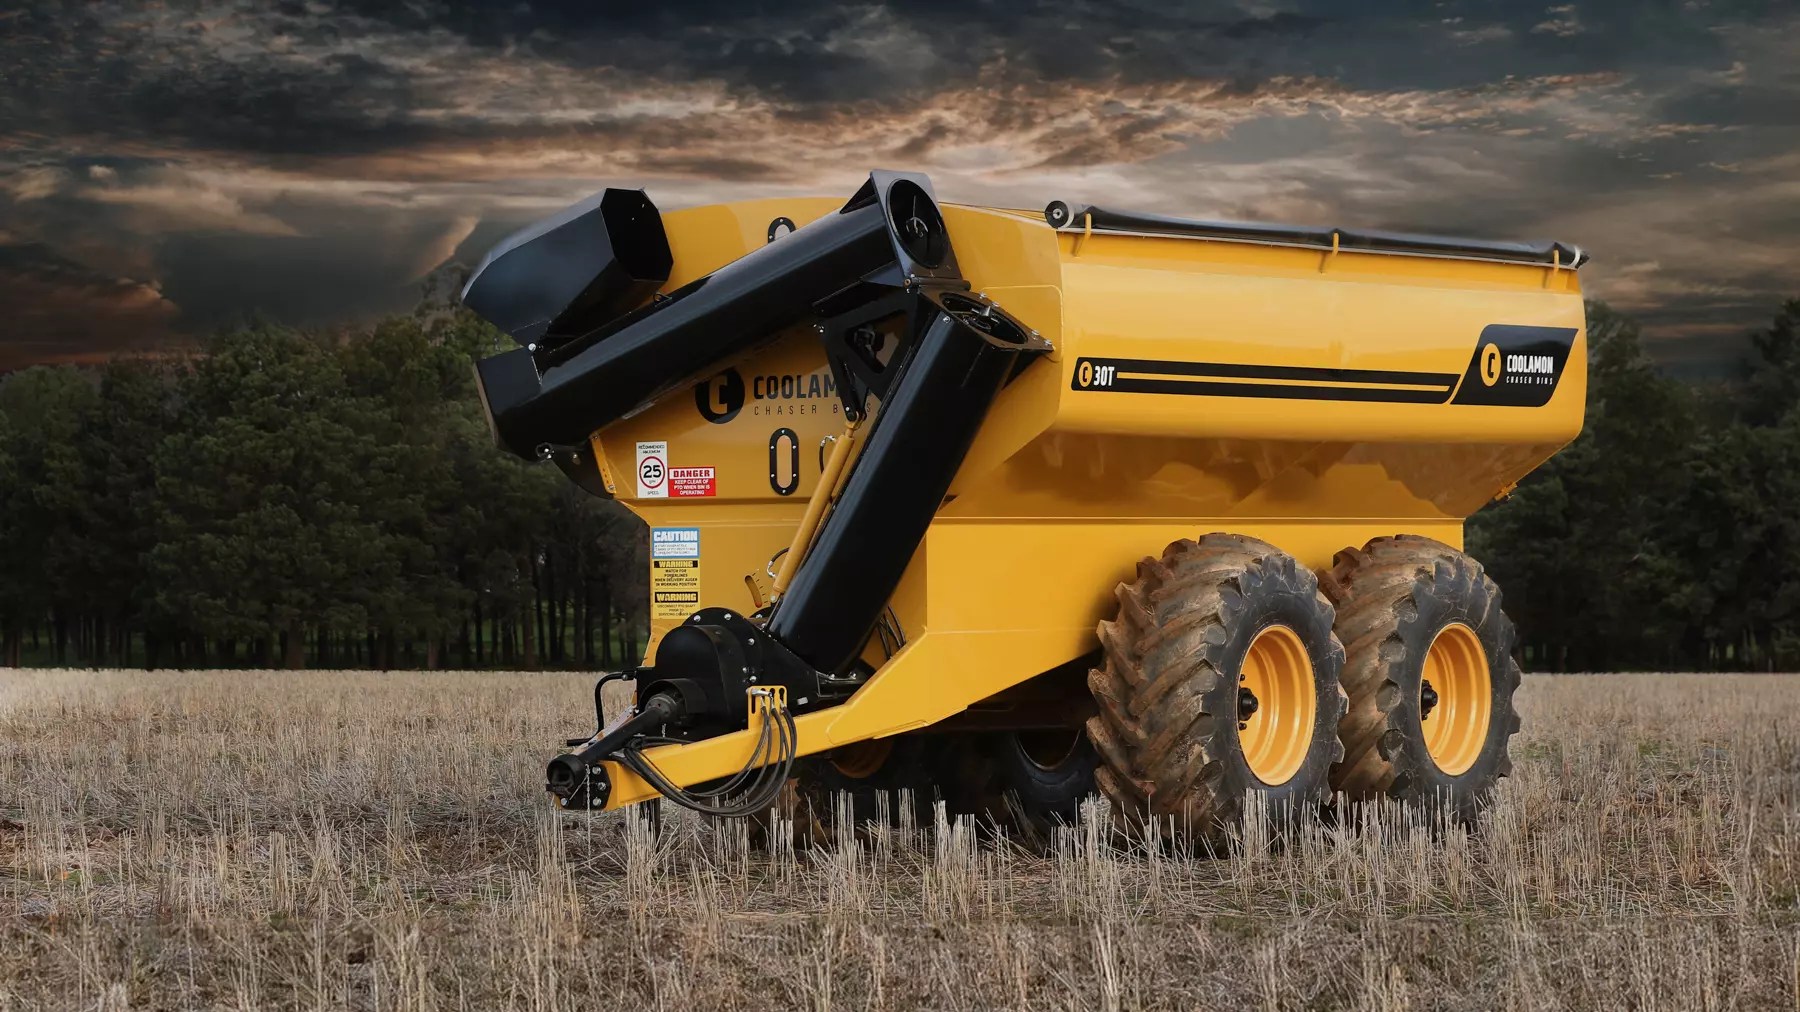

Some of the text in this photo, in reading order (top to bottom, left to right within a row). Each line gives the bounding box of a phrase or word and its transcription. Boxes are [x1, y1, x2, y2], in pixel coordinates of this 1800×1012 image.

[1506, 354, 1554, 374] COOLAMON
[1093, 365, 1115, 386] 30T
[1506, 376, 1553, 385] CHASER BINS
[753, 374, 842, 400] COOLAM
[754, 403, 871, 416] CHASER BS
[643, 465, 662, 478] 25
[673, 470, 710, 478] DANGER
[653, 531, 698, 541] CAUTION
[658, 560, 693, 568] WARNING
[656, 593, 697, 602] WARNING
